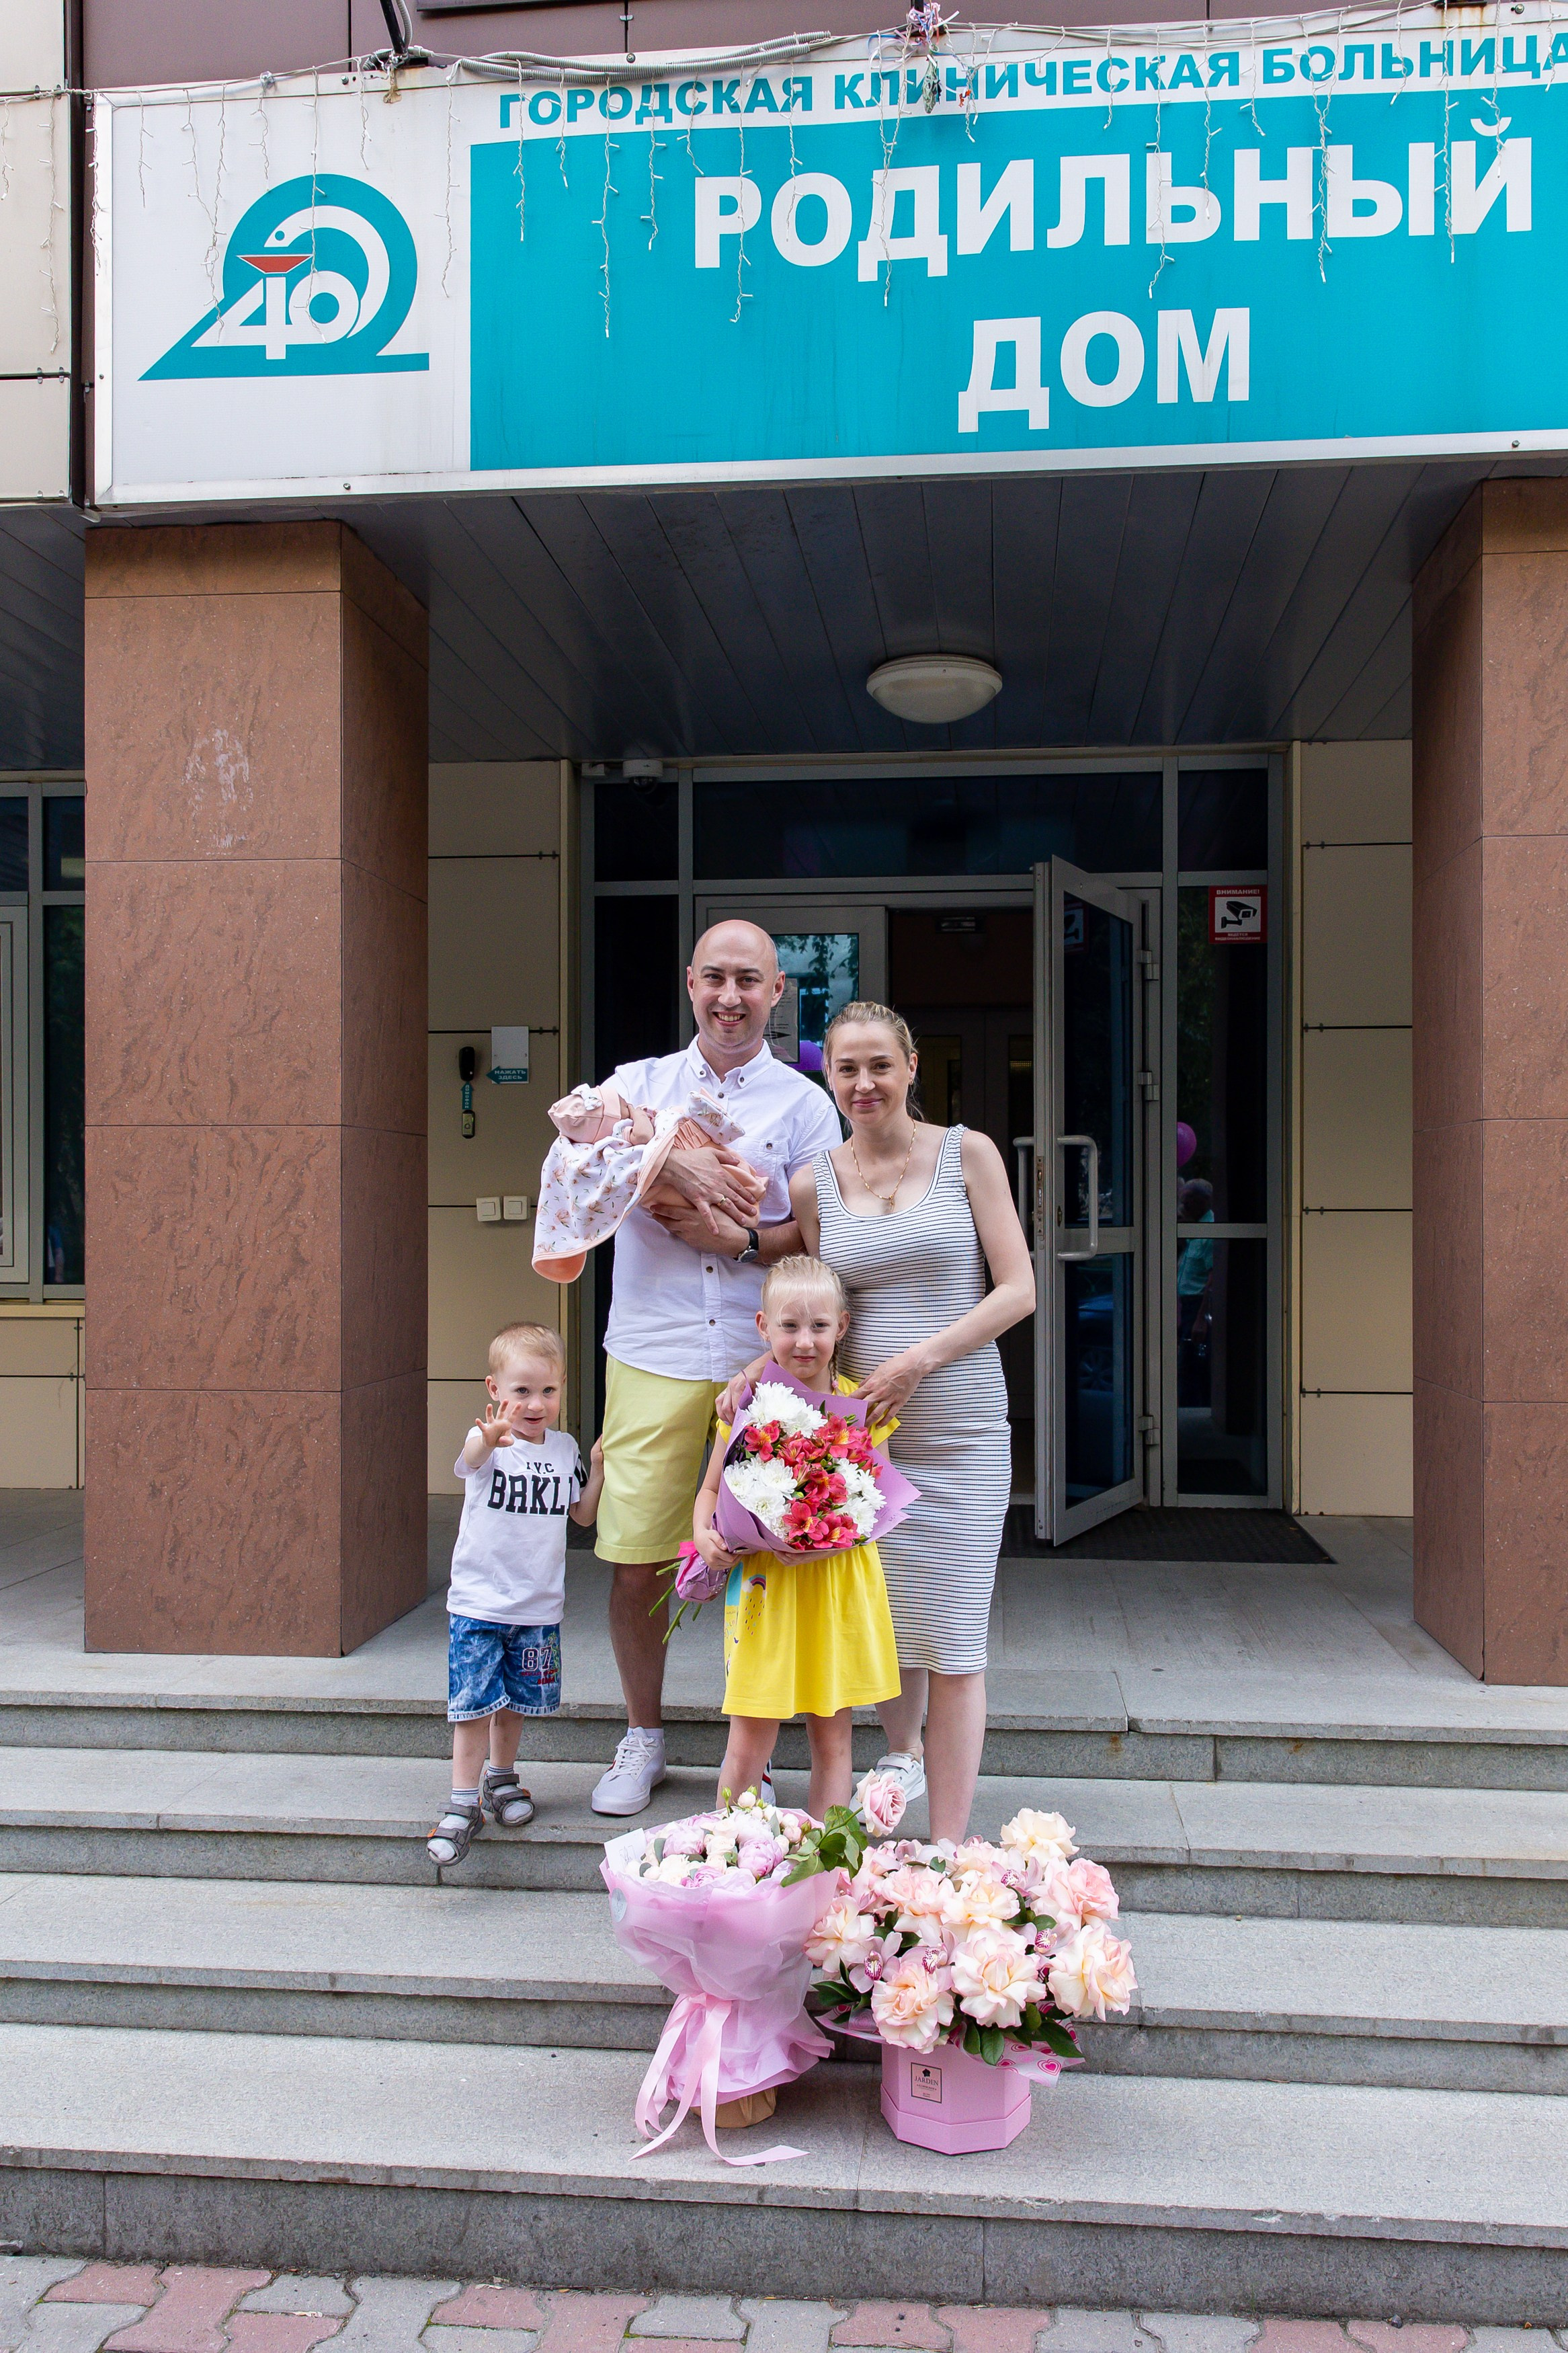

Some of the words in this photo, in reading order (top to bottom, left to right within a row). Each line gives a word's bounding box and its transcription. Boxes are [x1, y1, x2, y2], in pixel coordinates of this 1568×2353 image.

[499, 76, 813, 128] ГОРОДСКАЯ
[834, 51, 1240, 110] КЛИНИЧЕСКАЯ
[1262, 32, 1568, 85] БОЛЬНИЦА
[694, 117, 1532, 282] РОДИЛЬНЫЙ
[958, 307, 1250, 433] ДОМ
[522, 1645, 552, 1672] 87
[914, 2075, 939, 2086] JARDEN
